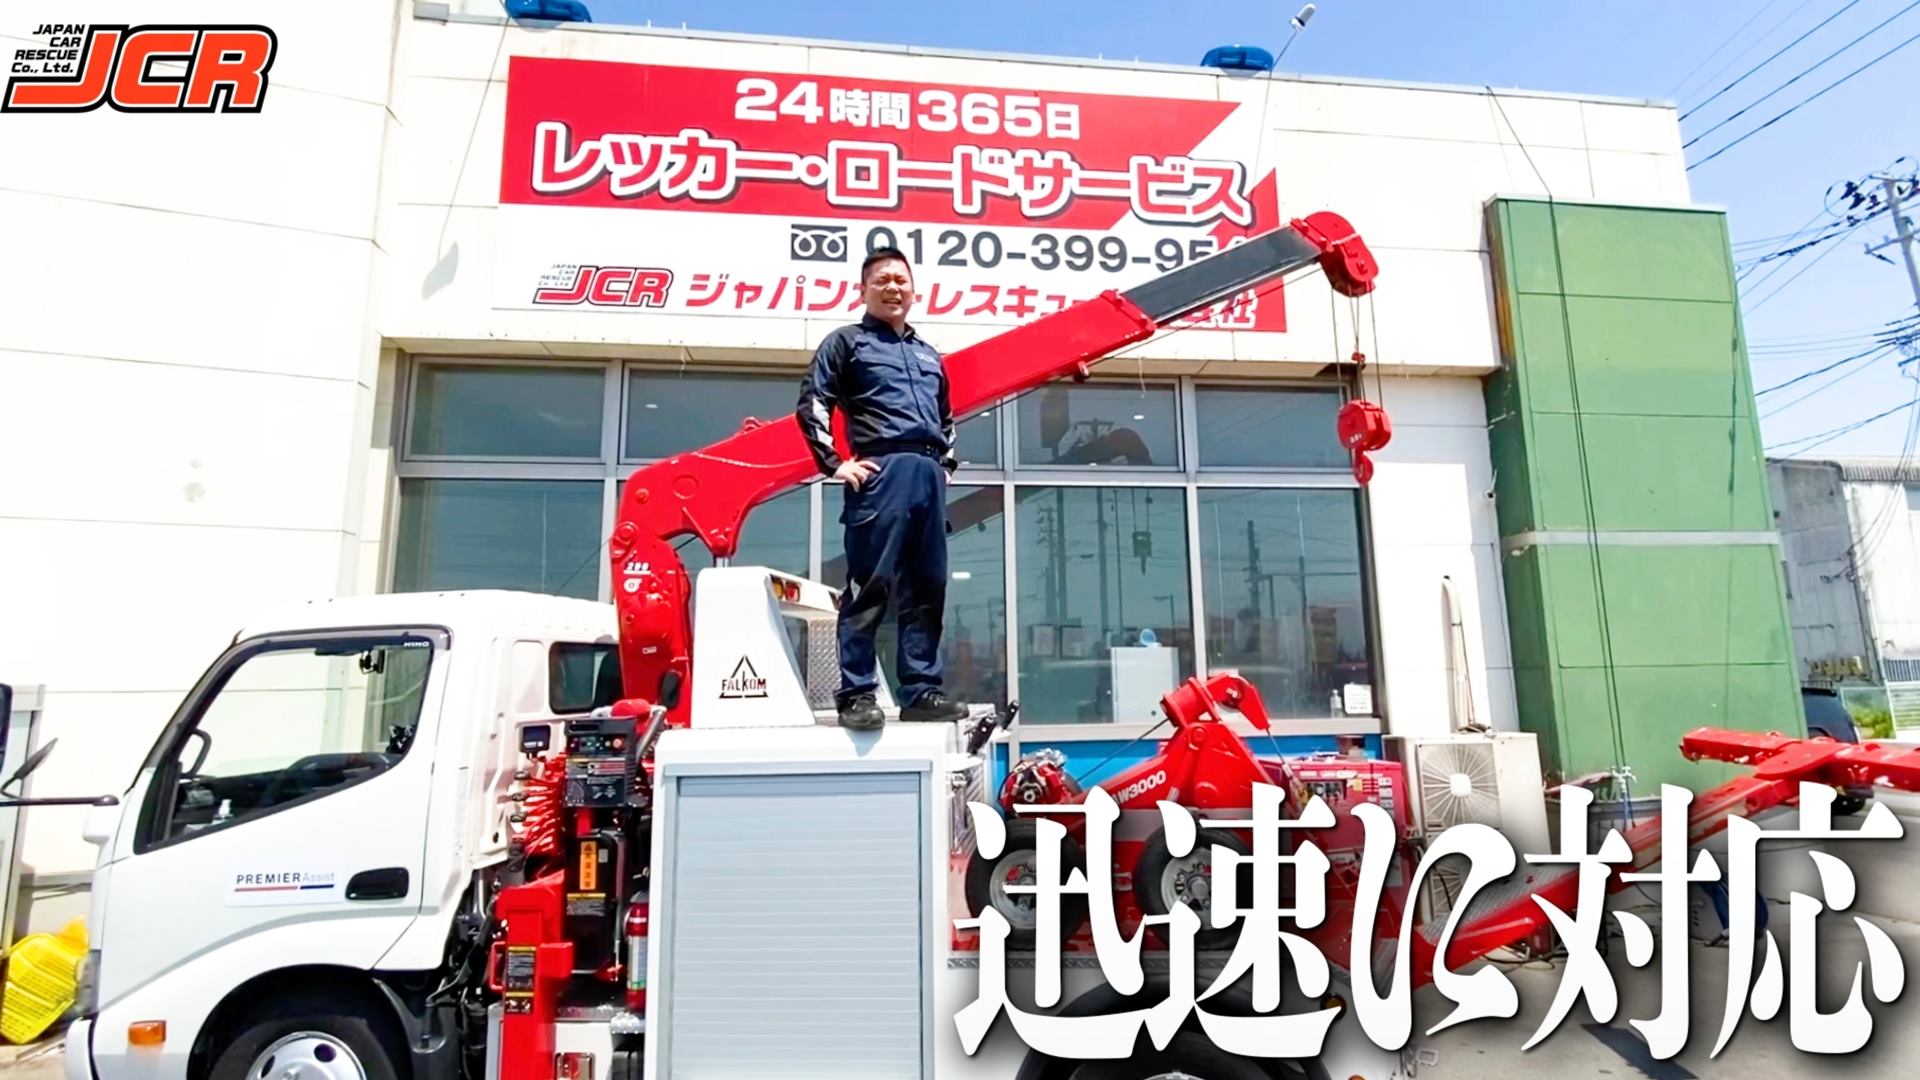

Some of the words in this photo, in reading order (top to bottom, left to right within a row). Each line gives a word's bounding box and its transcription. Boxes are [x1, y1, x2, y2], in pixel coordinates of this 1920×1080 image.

[531, 121, 1256, 230] レッカー・ロードサービス
[865, 226, 1244, 274] 0120-399-95
[532, 265, 674, 308] JCR
[721, 671, 767, 692] FALKOM
[236, 872, 301, 885] PREMIER
